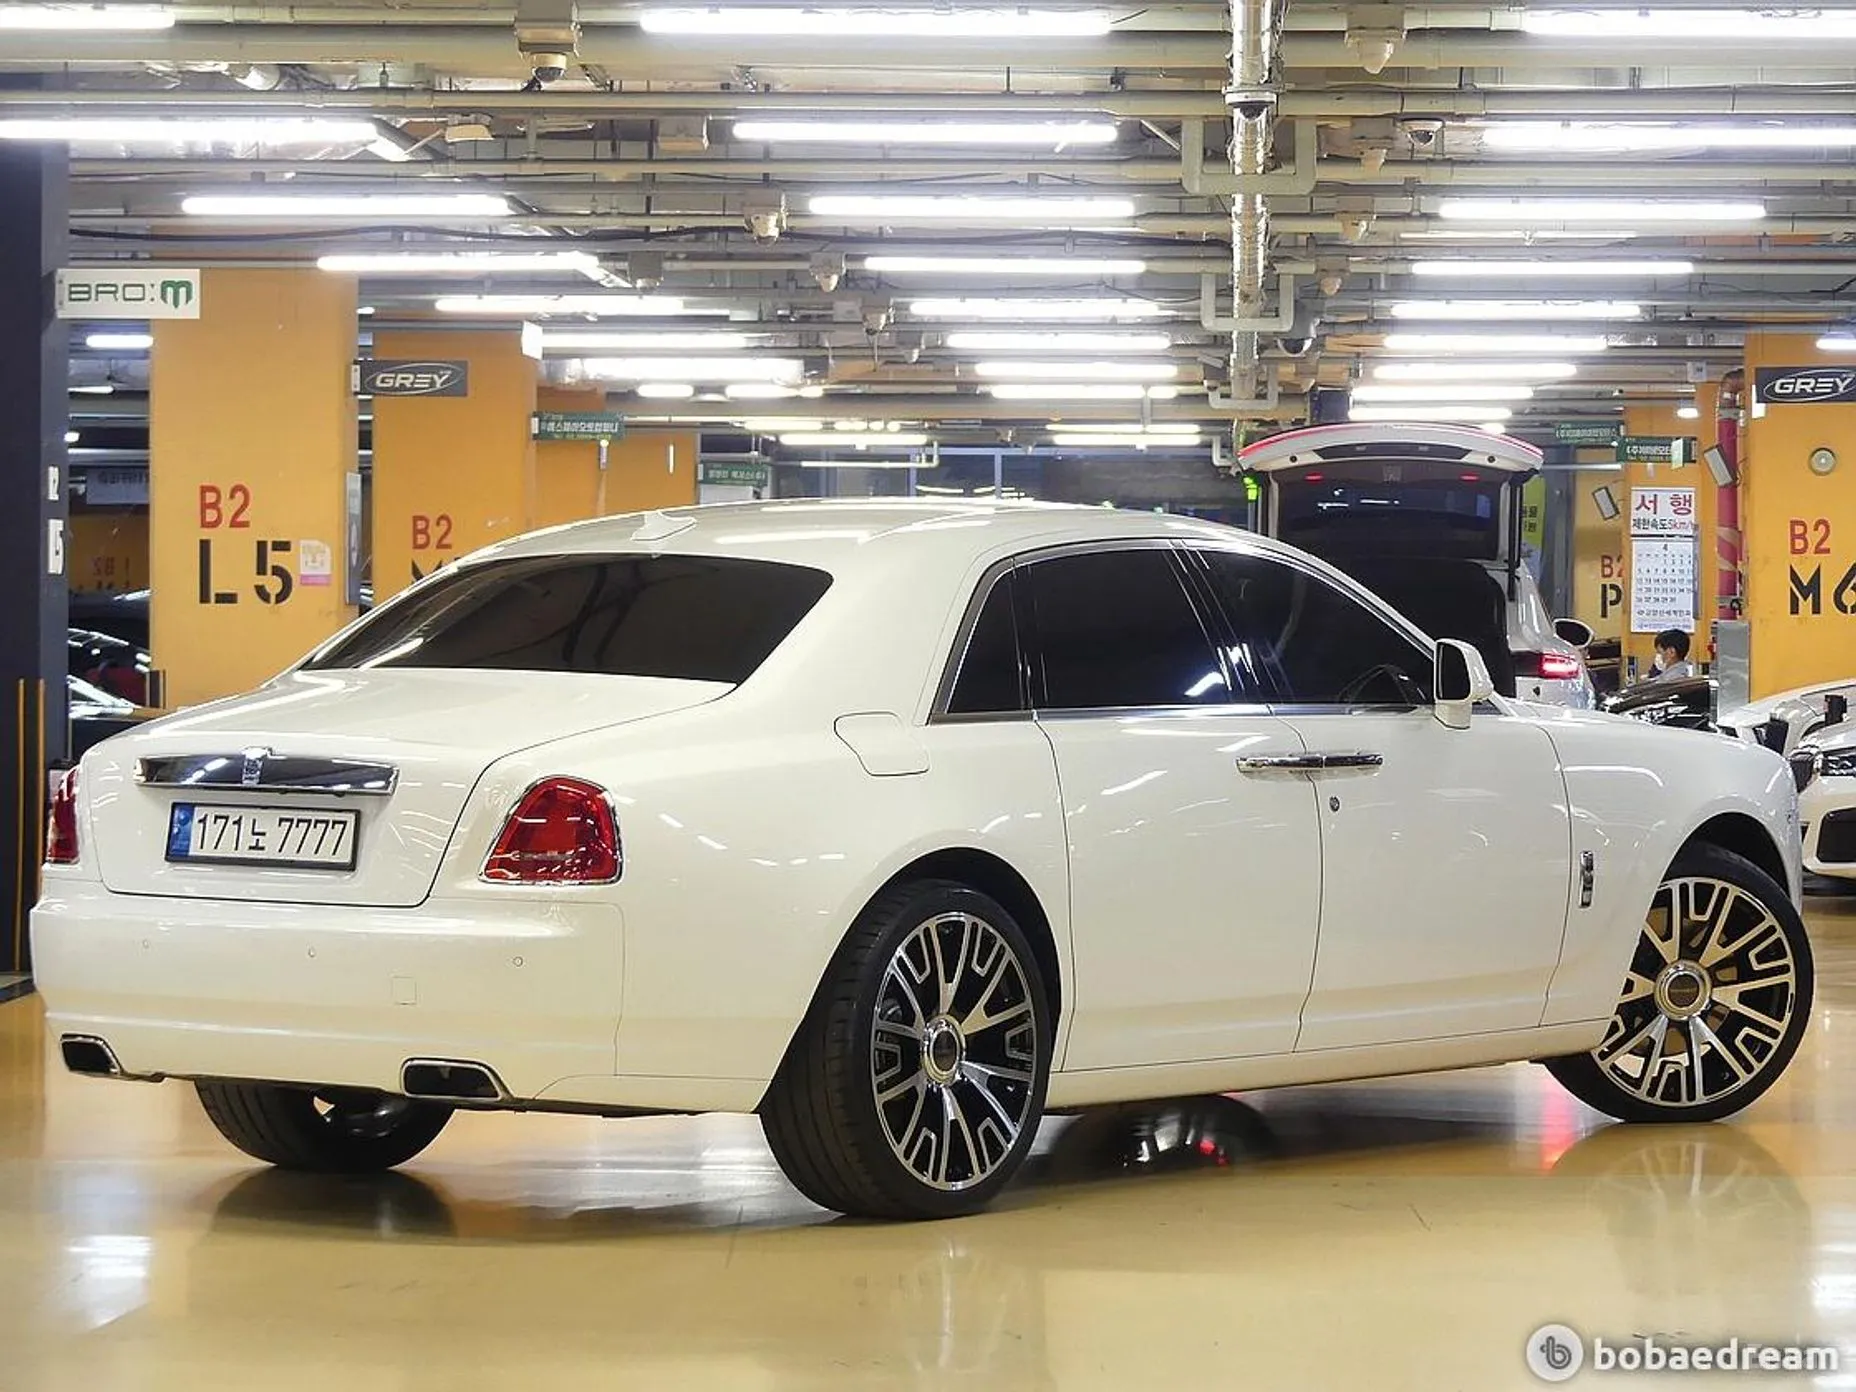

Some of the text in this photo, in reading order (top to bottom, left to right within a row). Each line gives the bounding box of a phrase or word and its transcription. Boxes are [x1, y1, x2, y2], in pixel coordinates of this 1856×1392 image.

[375, 373, 450, 388] GREY
[1774, 377, 1853, 394] GREY
[199, 483, 251, 529] B2
[411, 513, 453, 550] B2
[1789, 519, 1831, 555] B2
[197, 813, 348, 856] 171노 7777
